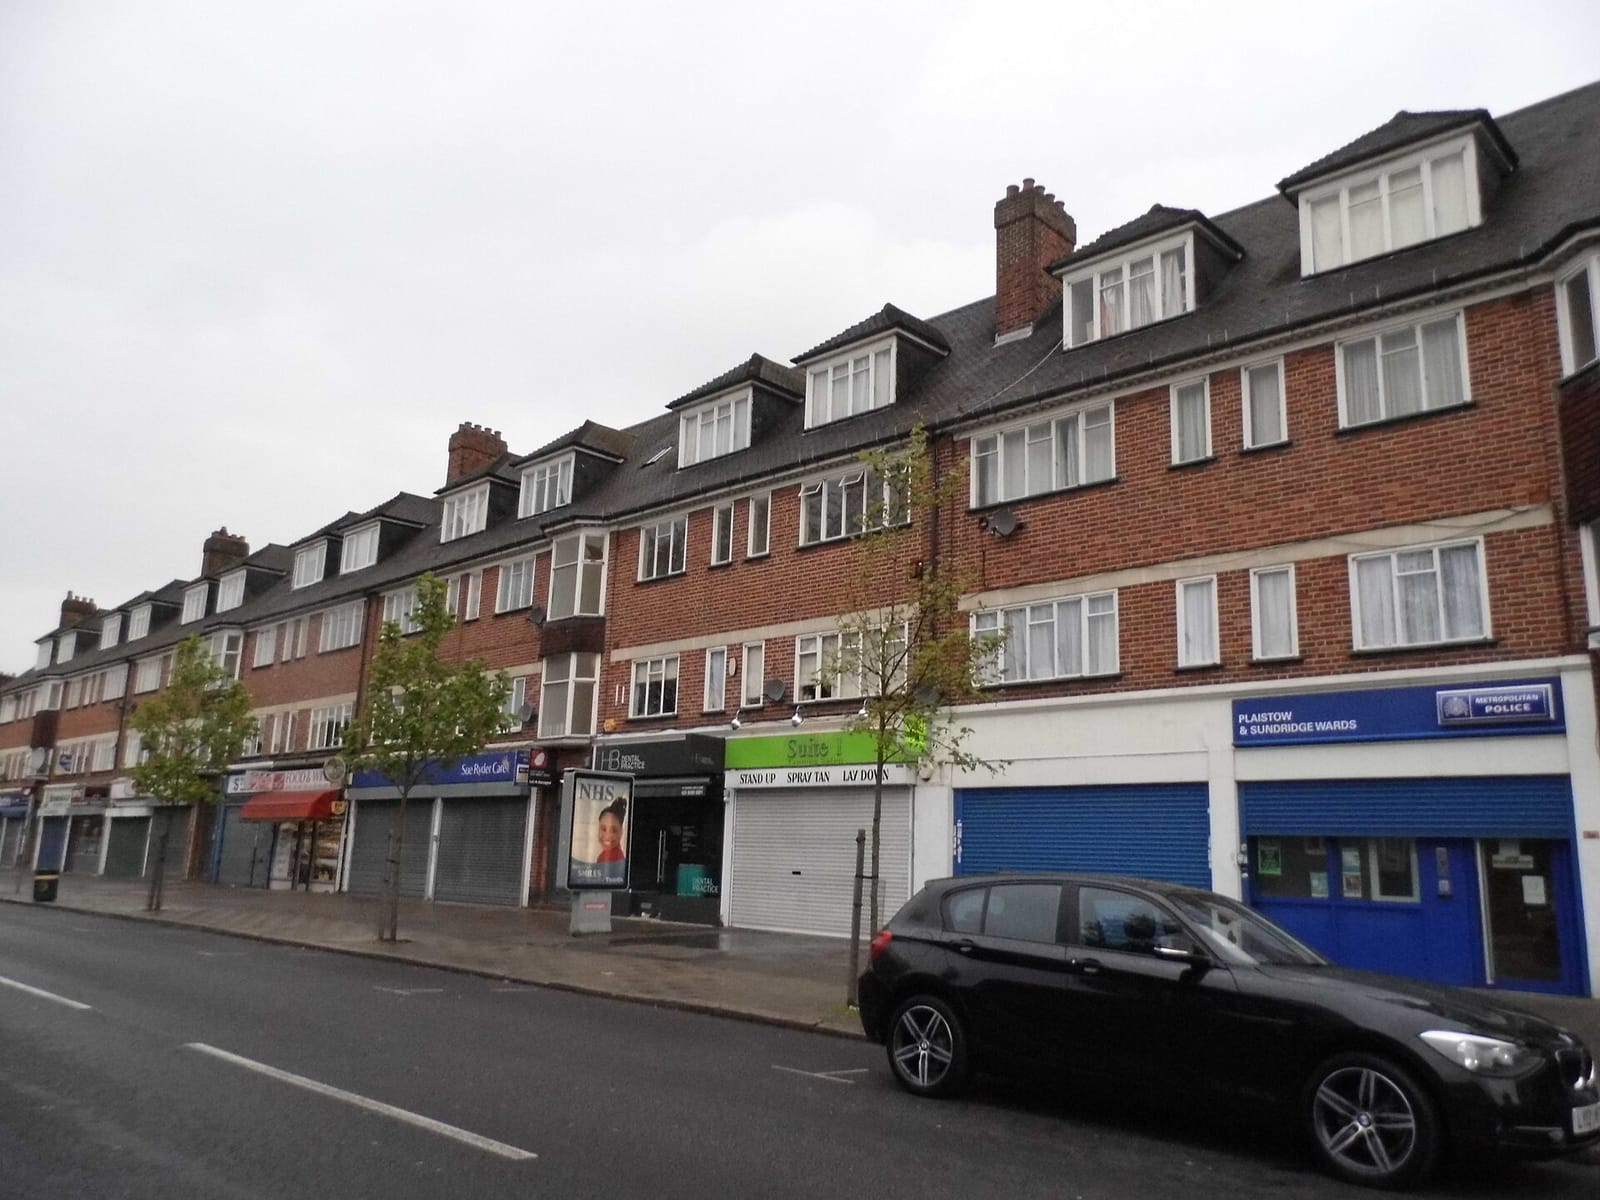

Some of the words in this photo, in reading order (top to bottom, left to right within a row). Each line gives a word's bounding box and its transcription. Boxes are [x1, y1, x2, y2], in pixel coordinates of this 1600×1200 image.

[1475, 694, 1538, 704] METROPOLITAN
[1485, 703, 1531, 713] POLICE
[1238, 711, 1292, 723] PLAISTOW
[1239, 725, 1248, 735] &
[1250, 722, 1313, 735] SUNDRIDGE
[1315, 719, 1357, 731] WARDS
[787, 738, 828, 759] Suite
[621, 754, 640, 762] DENTAL
[461, 763, 474, 776] Sue
[473, 763, 492, 776] Ryder
[621, 761, 645, 769] PRACTICE
[740, 774, 763, 784] STAND
[765, 773, 776, 784] UP
[787, 771, 812, 784] SPRAY
[814, 771, 830, 783] TAN
[843, 770, 858, 782] LAY
[580, 783, 614, 801] NHS
[692, 884, 719, 894] PRACTICE
